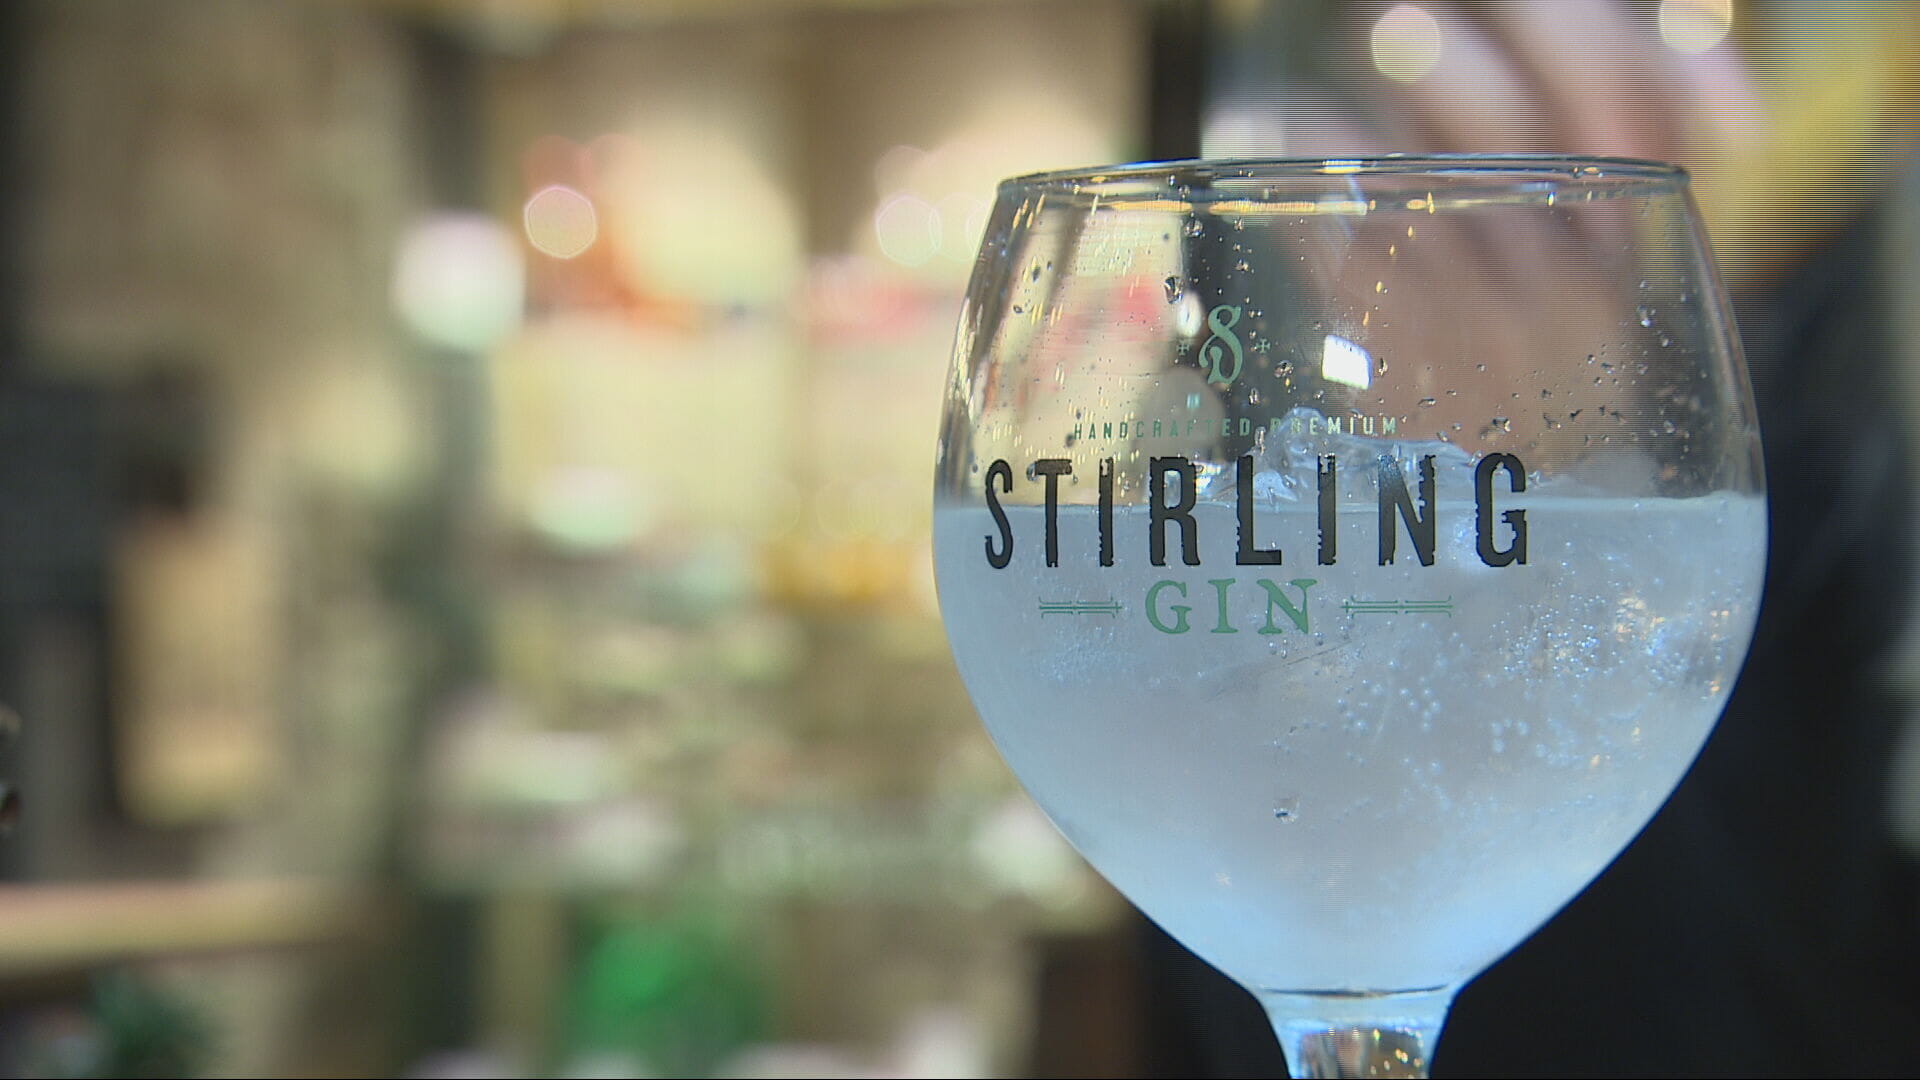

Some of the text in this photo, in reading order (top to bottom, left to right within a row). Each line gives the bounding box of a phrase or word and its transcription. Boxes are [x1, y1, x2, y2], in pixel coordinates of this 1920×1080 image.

[1073, 417, 1397, 440] HANDCRAFTED PREMIUM
[984, 452, 1528, 569] STIRLING
[1145, 578, 1318, 635] GIN
